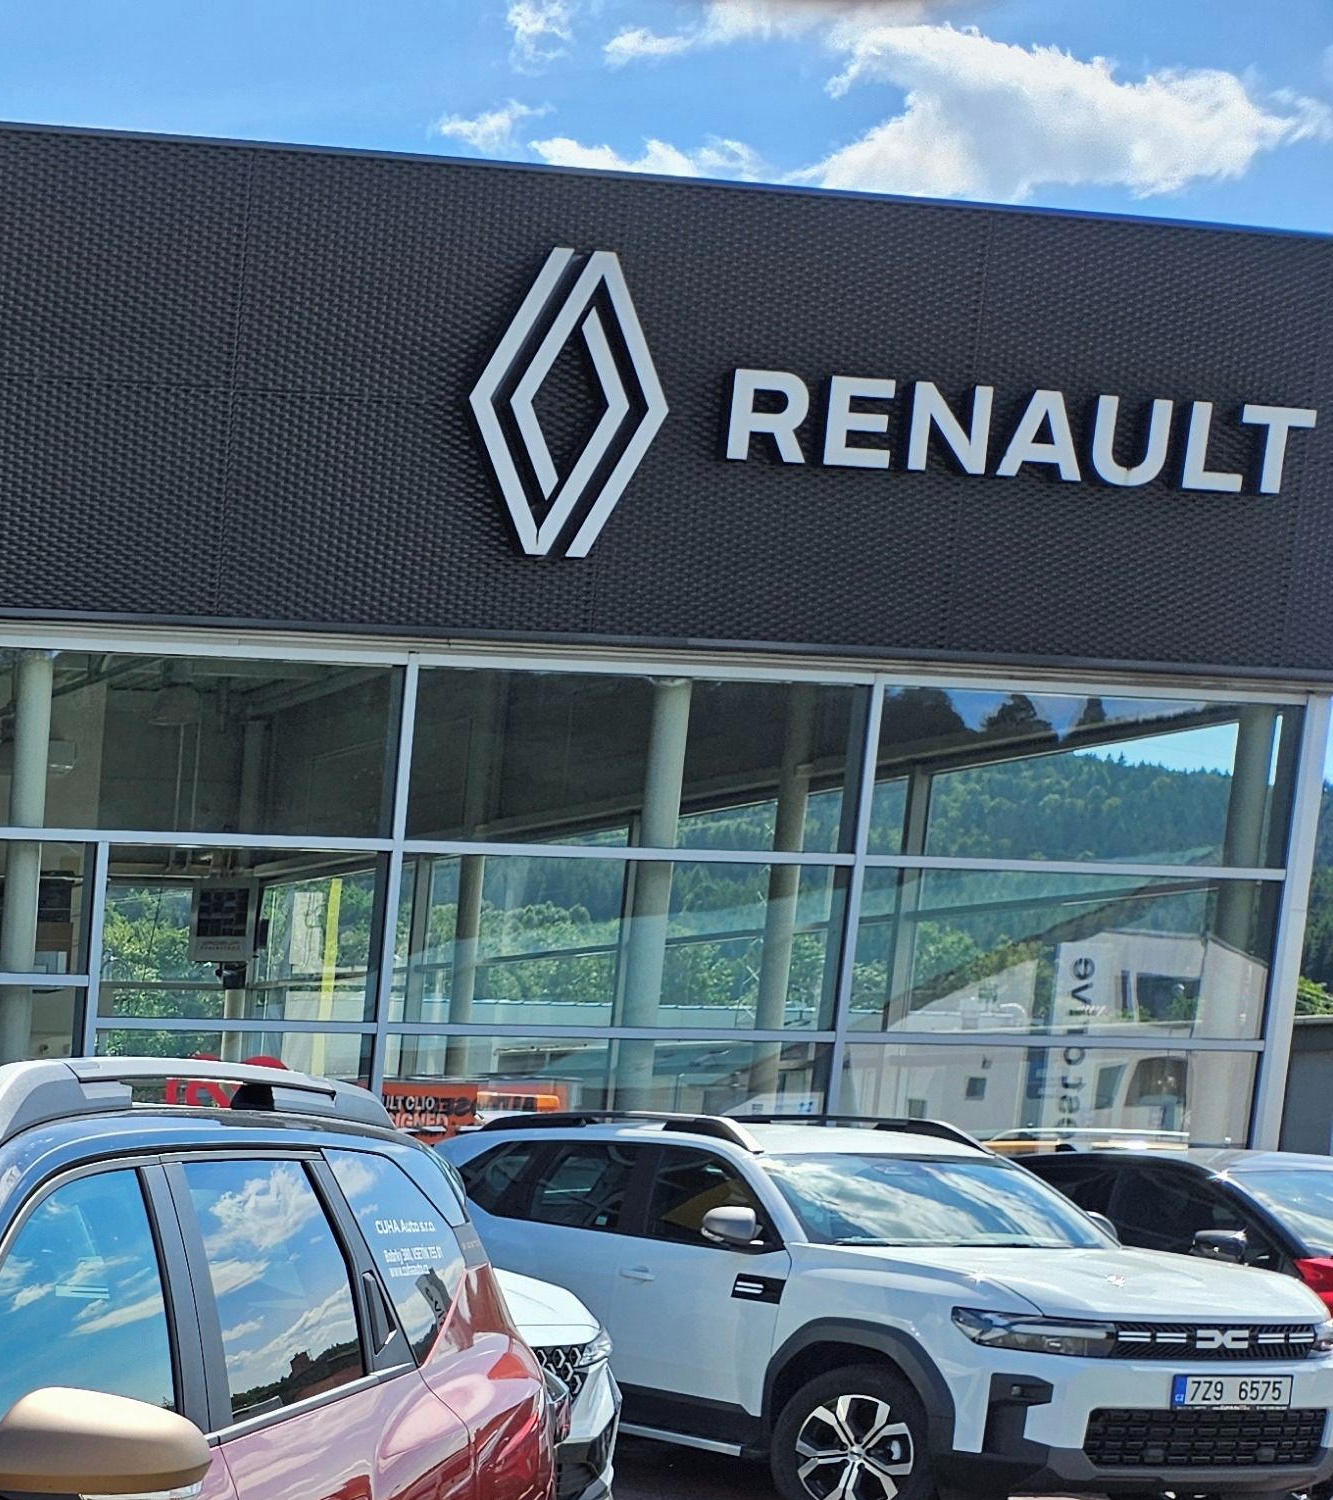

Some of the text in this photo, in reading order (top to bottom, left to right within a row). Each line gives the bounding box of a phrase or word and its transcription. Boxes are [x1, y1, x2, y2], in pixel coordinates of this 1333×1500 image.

[726, 368, 1317, 494] RENAULT
[405, 1096, 435, 1111] CLIO
[375, 1219, 400, 1234] CUHA
[1190, 1380, 1224, 1401] 7Z9
[1238, 1380, 1283, 1401] 6575
